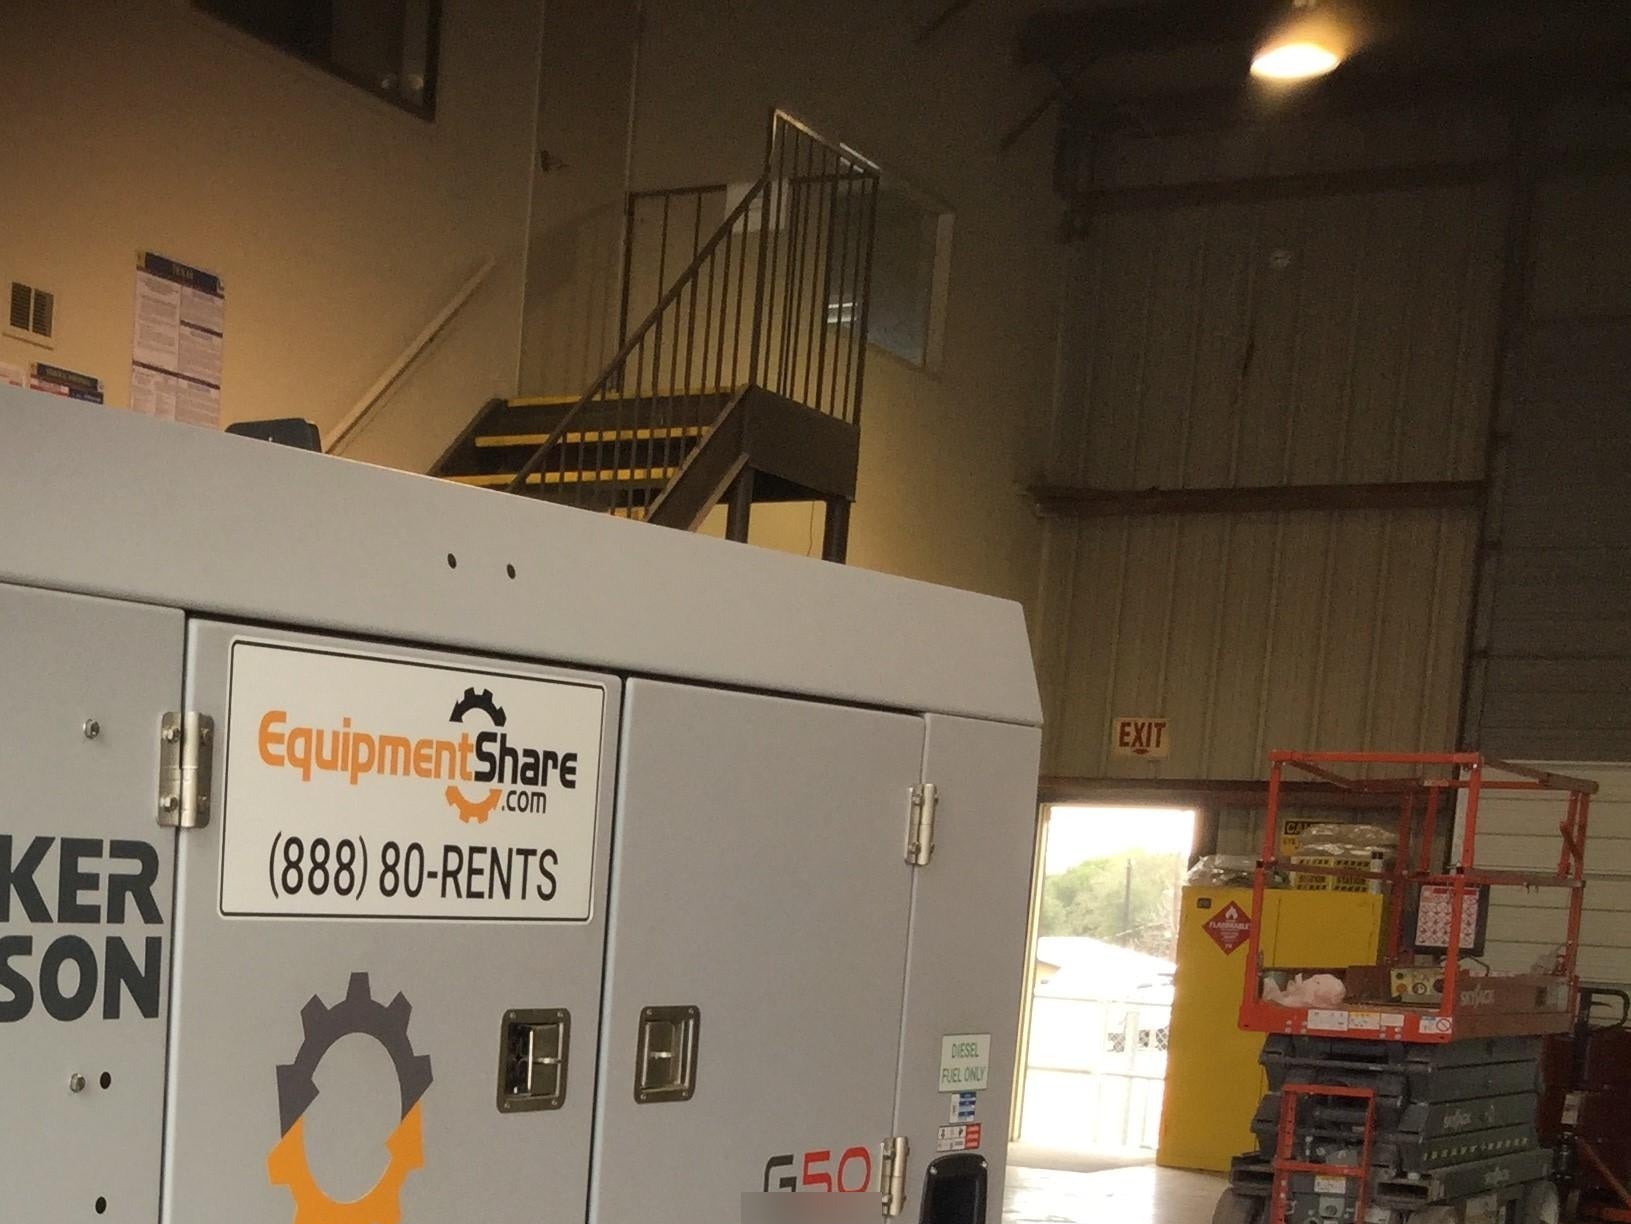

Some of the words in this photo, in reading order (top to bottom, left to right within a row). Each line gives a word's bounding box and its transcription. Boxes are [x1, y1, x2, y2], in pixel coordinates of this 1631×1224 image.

[1119, 721, 1167, 748] EXIT
[258, 710, 578, 789] EquipmentShare
[501, 789, 547, 814] .com
[268, 831, 368, 901] (888)
[379, 841, 560, 901] 80-RENTS
[951, 1042, 979, 1058] DIESEL
[942, 1067, 962, 1083] FUEL
[964, 1066, 986, 1082] ONLY
[764, 1146, 872, 1192] G50
